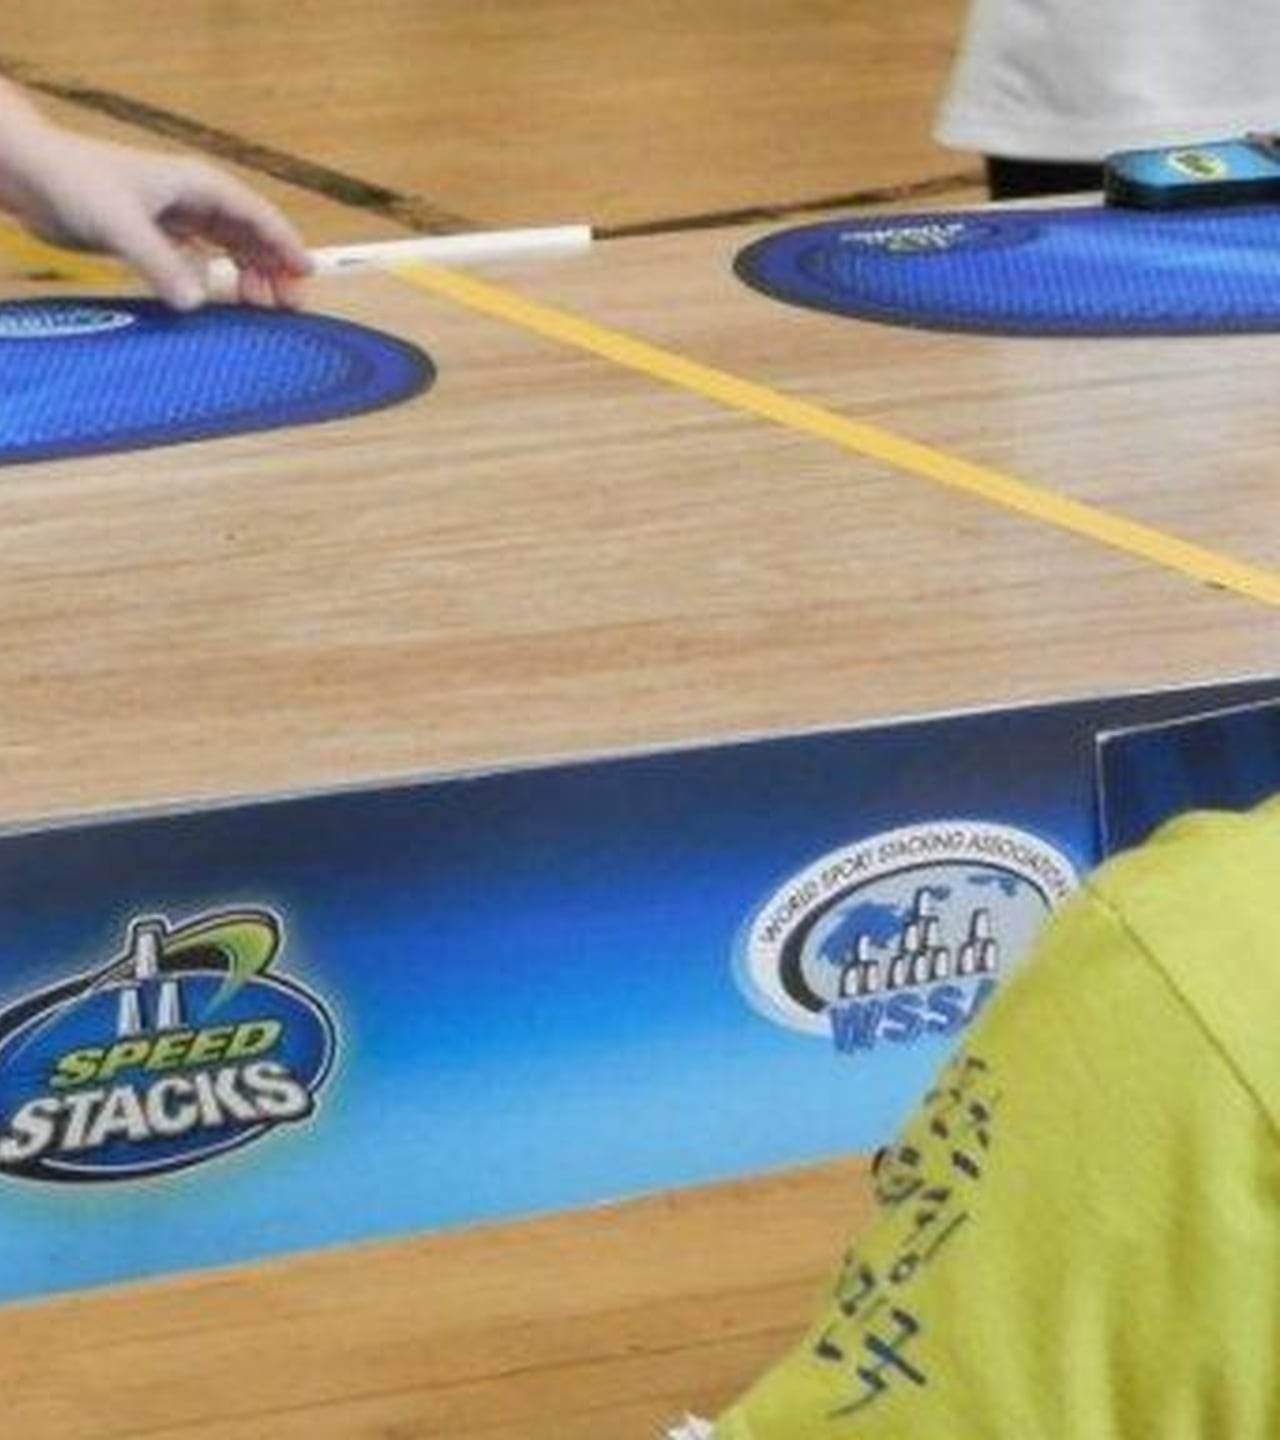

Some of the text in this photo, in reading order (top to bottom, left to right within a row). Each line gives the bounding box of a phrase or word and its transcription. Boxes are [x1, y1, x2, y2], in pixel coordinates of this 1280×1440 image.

[758, 881, 823, 945] WORLD
[820, 850, 874, 890] SPORT
[877, 828, 964, 863] STACKING
[49, 1018, 283, 1087] SPEED
